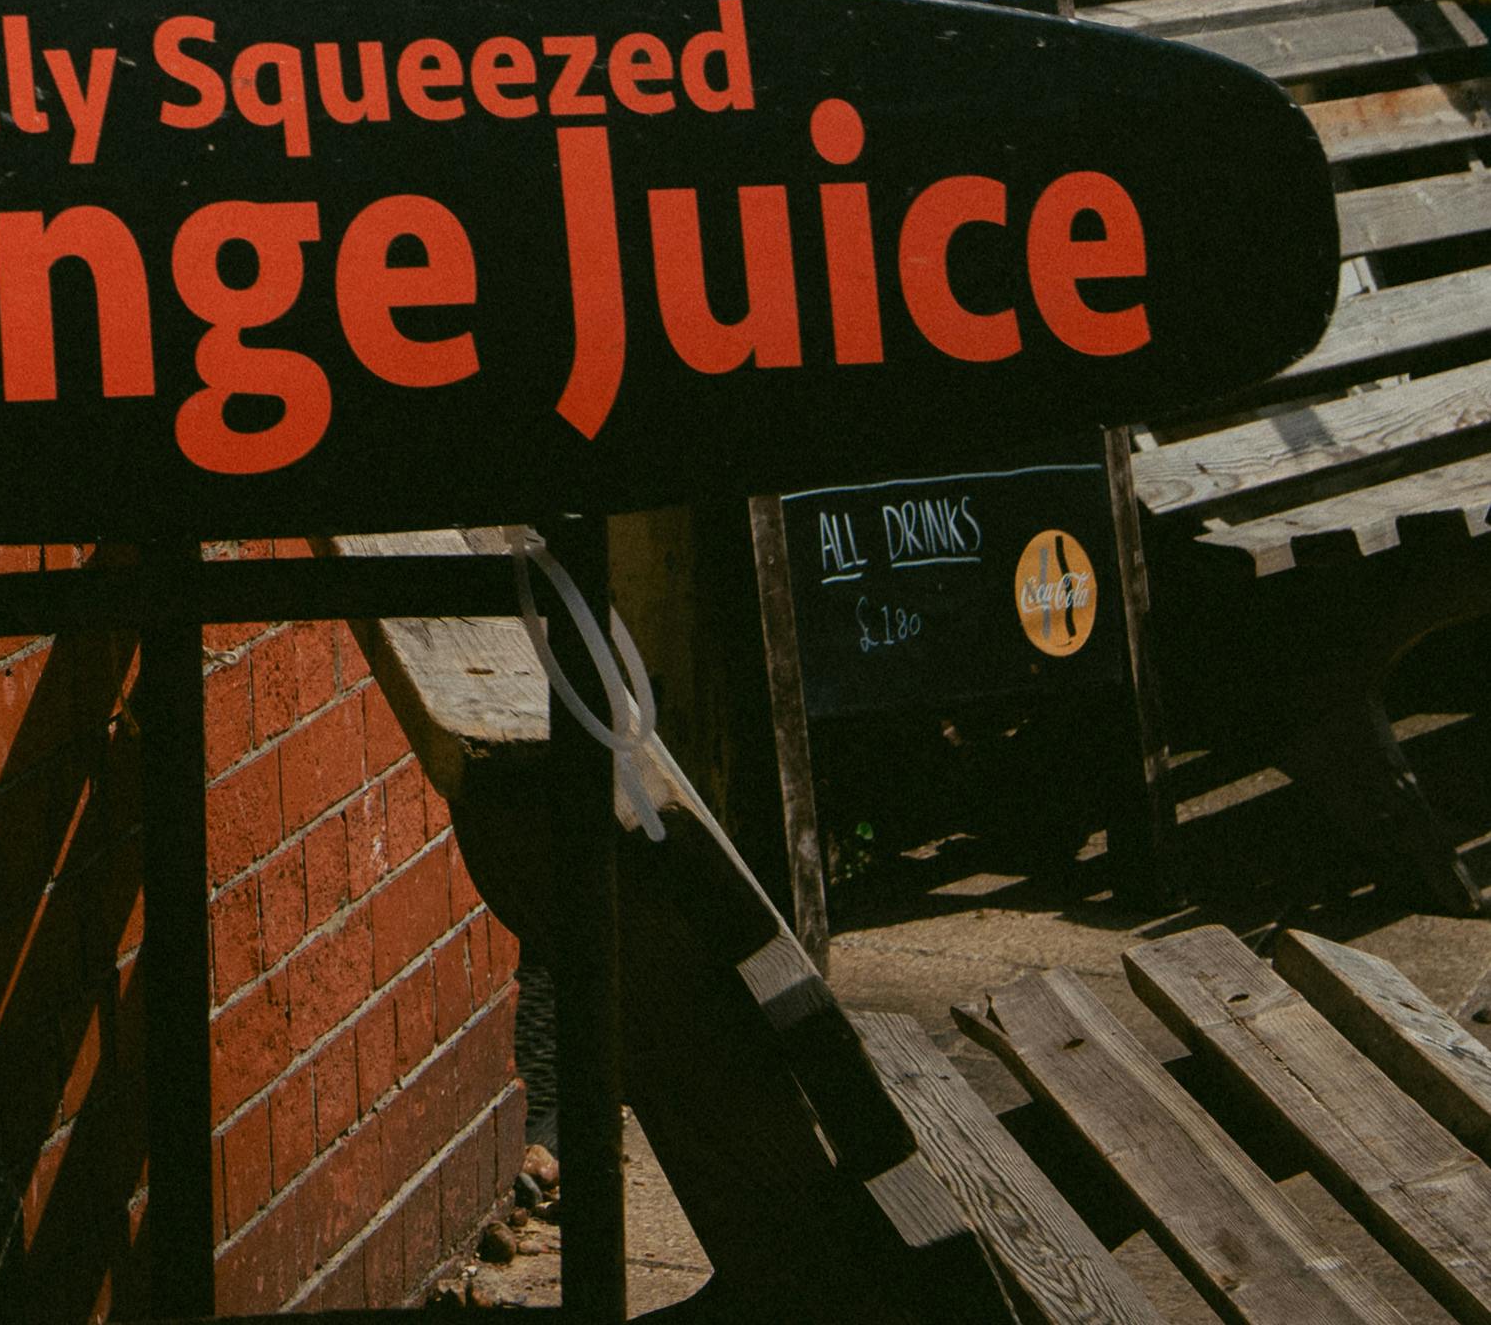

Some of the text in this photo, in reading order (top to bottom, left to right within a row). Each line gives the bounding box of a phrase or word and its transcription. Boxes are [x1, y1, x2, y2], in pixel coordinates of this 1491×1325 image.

[558, 99, 1150, 439] Juice
[820, 496, 980, 571] ALL DRINKS
